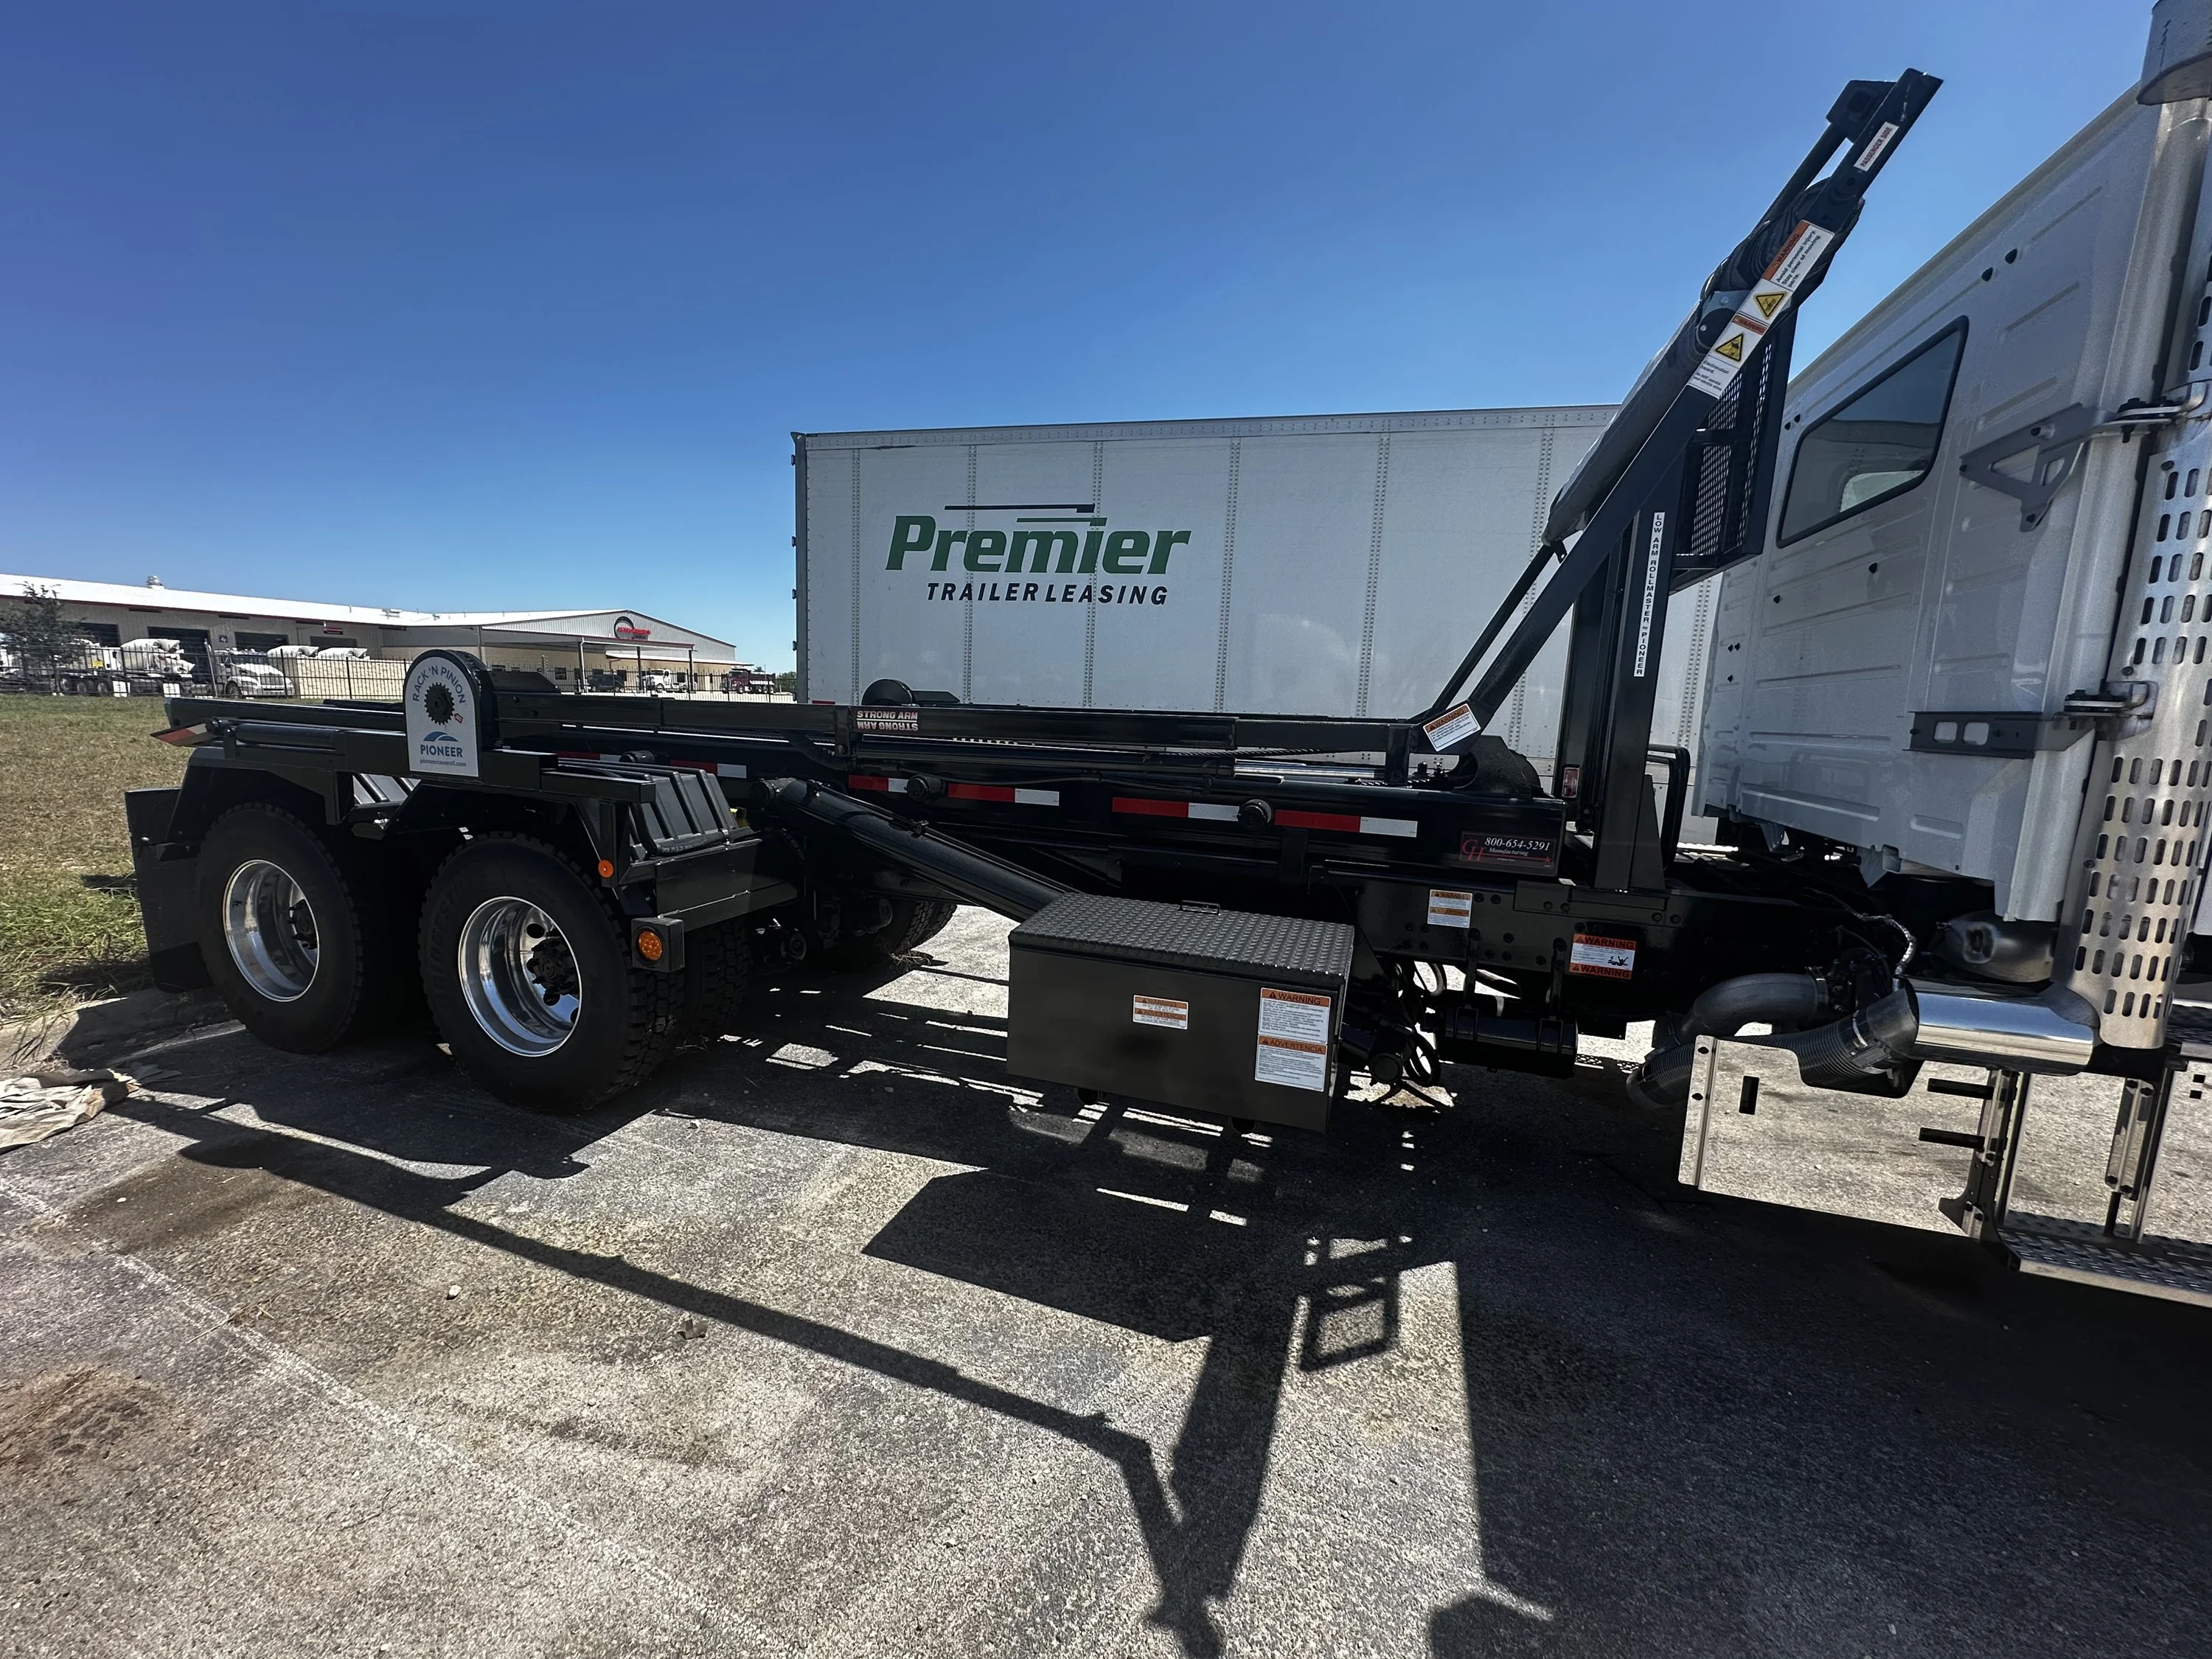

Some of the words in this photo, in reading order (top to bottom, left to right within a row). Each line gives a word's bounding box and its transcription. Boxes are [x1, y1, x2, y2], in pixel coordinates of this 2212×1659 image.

[1860, 139, 1884, 167] PASSENGER
[1881, 127, 1893, 139] SIDE
[1775, 233, 1800, 264] WARNING
[1776, 268, 1789, 282] Avoid
[1787, 246, 1804, 268] personal
[1781, 274, 1792, 285] Stay
[1791, 260, 1801, 273] clear
[1804, 235, 1820, 254] moving
[1739, 319, 1765, 333] WARNING
[1703, 361, 1730, 374] Electrocution
[1654, 515, 1662, 533] LOW
[885, 515, 1192, 574] Premier
[1651, 538, 1659, 556] ARM
[928, 582, 1039, 602] TRAILER
[1044, 584, 1168, 605] LEASING
[1643, 560, 1657, 622] ROLLMASTER
[1636, 632, 1647, 675] PIONEER
[412, 669, 429, 702] RACK
[440, 667, 466, 703] PINION
[857, 710, 896, 719] STRONG
[897, 712, 918, 720] ARM
[1434, 709, 1464, 728] WARNING
[878, 722, 919, 731] STRONG
[420, 745, 463, 757] PIONEER
[1484, 837, 1551, 851] 800-654-5291
[1489, 847, 1529, 857] Manufacturing
[1585, 936, 1635, 949] WARNING
[1581, 964, 1630, 978] WARNING
[1148, 998, 1177, 1007] WARNING
[1279, 992, 1321, 1006] WARNING
[1144, 1009, 1183, 1020] ADVERTENCIA
[1270, 1039, 1323, 1053] ADVERTENCIA
